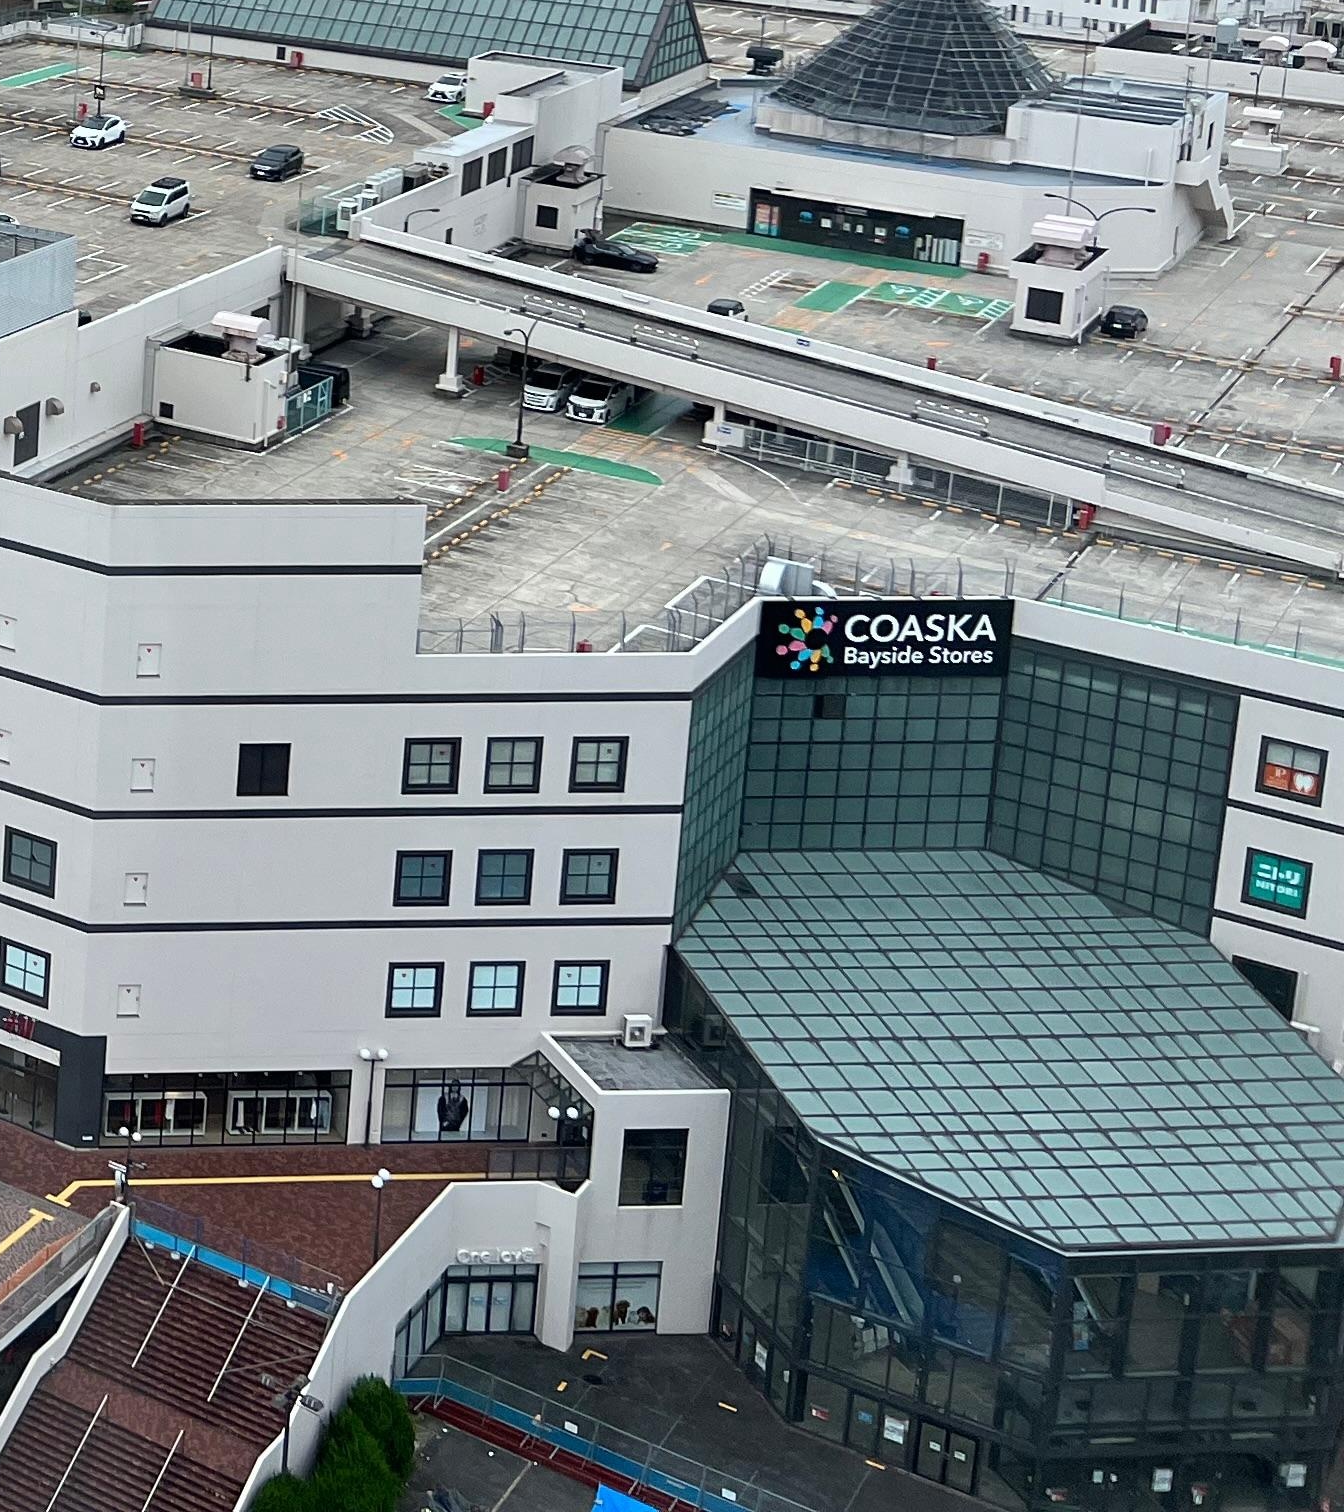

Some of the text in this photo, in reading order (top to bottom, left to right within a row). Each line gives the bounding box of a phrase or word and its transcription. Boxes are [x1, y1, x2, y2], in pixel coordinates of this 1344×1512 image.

[844, 614, 997, 642] COASKA
[844, 646, 994, 668] Bayside Stores
[1257, 863, 1301, 885] ニトリ
[1255, 879, 1299, 898] NITORI
